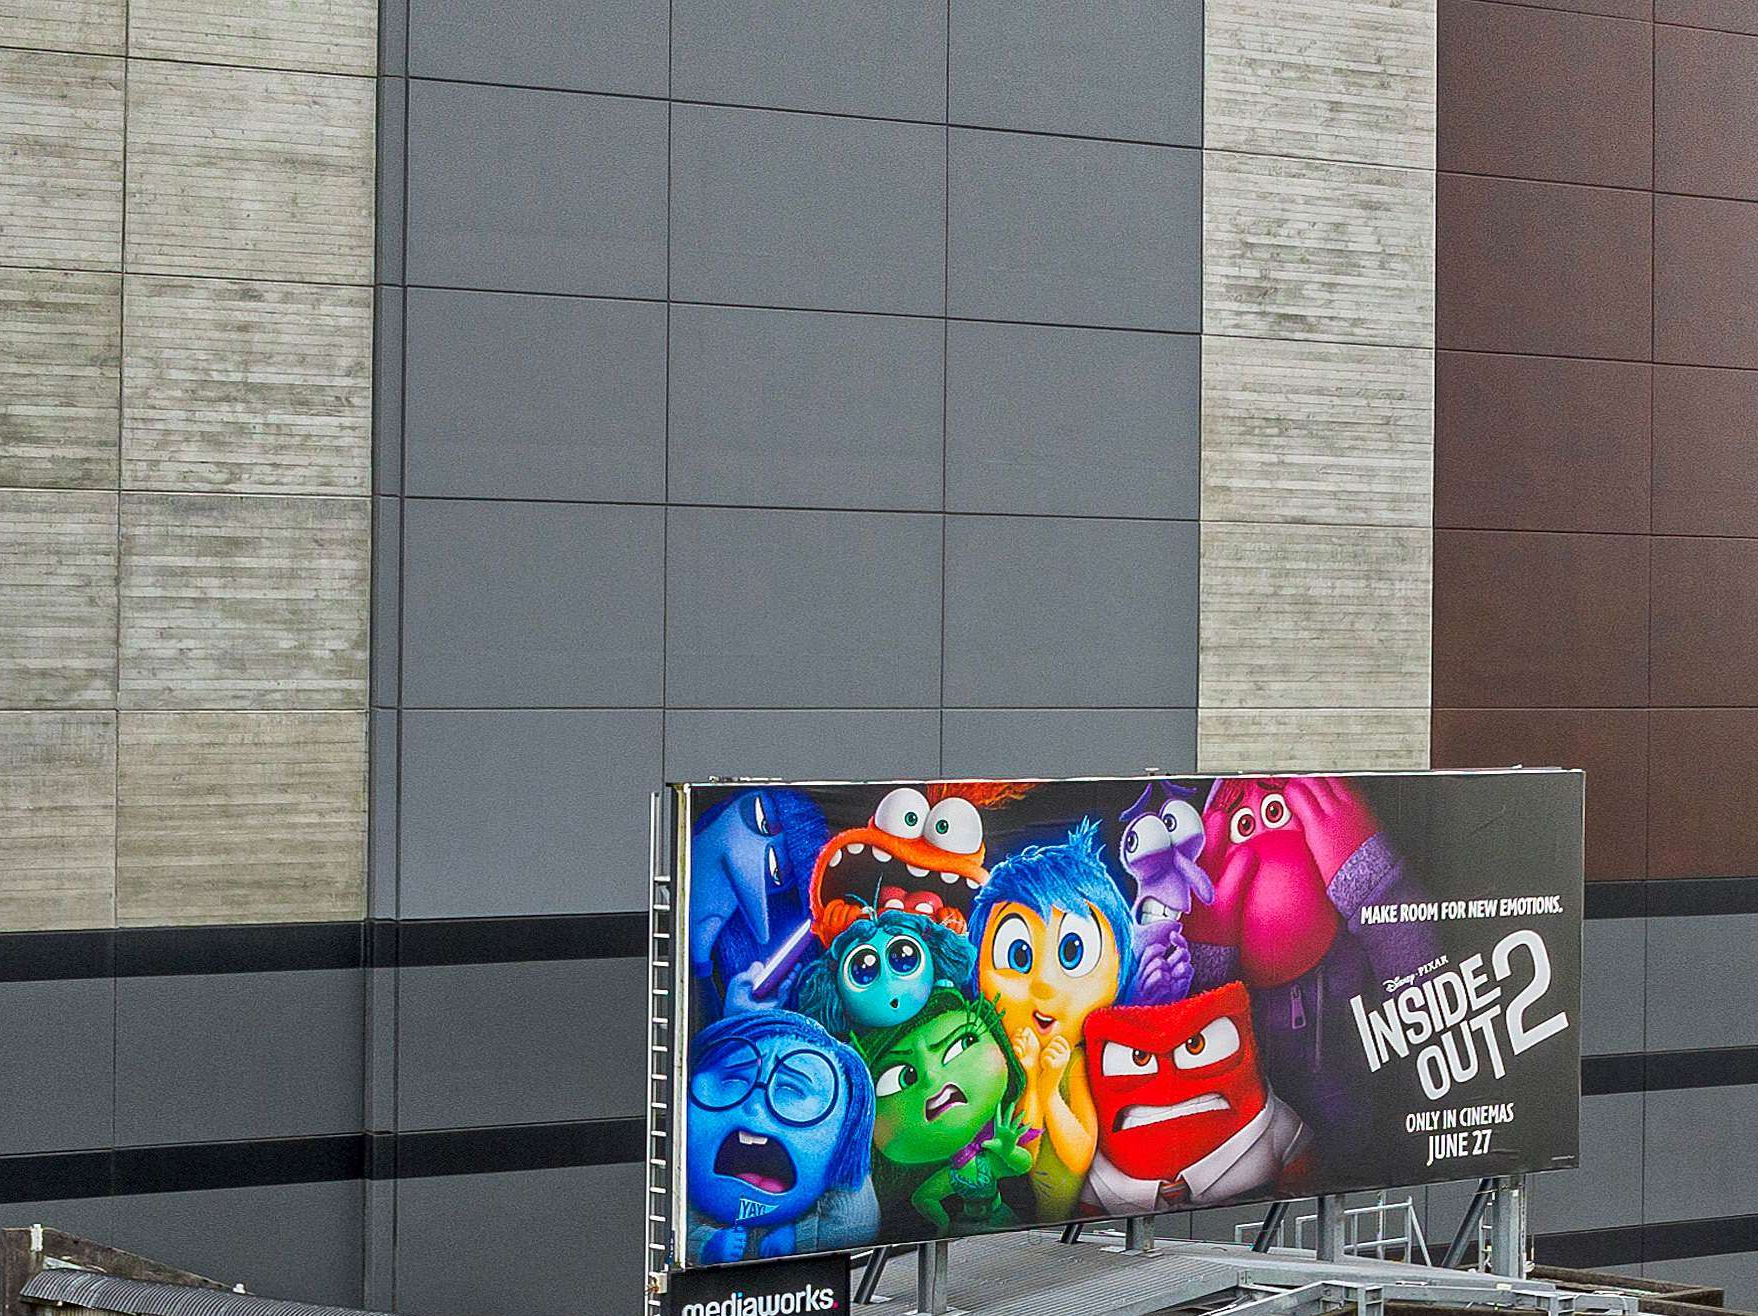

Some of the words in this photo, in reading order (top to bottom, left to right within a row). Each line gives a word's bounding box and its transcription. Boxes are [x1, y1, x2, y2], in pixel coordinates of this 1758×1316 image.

[1361, 905, 1398, 925] MAKE
[1400, 901, 1438, 922] ROOM
[1441, 901, 1466, 920] FOR
[1468, 899, 1497, 919] NEW
[1499, 895, 1563, 918] EMOTIONS.
[1350, 953, 1502, 1073] INSIDE
[1416, 1004, 1506, 1101] OUT
[1492, 929, 1569, 1056] 2
[1406, 1112, 1440, 1133] ONLY
[1443, 1110, 1457, 1130] IN
[1459, 1102, 1515, 1128] CINEMAS
[1426, 1133, 1468, 1167] JUNE
[1472, 1129, 1492, 1155] 27
